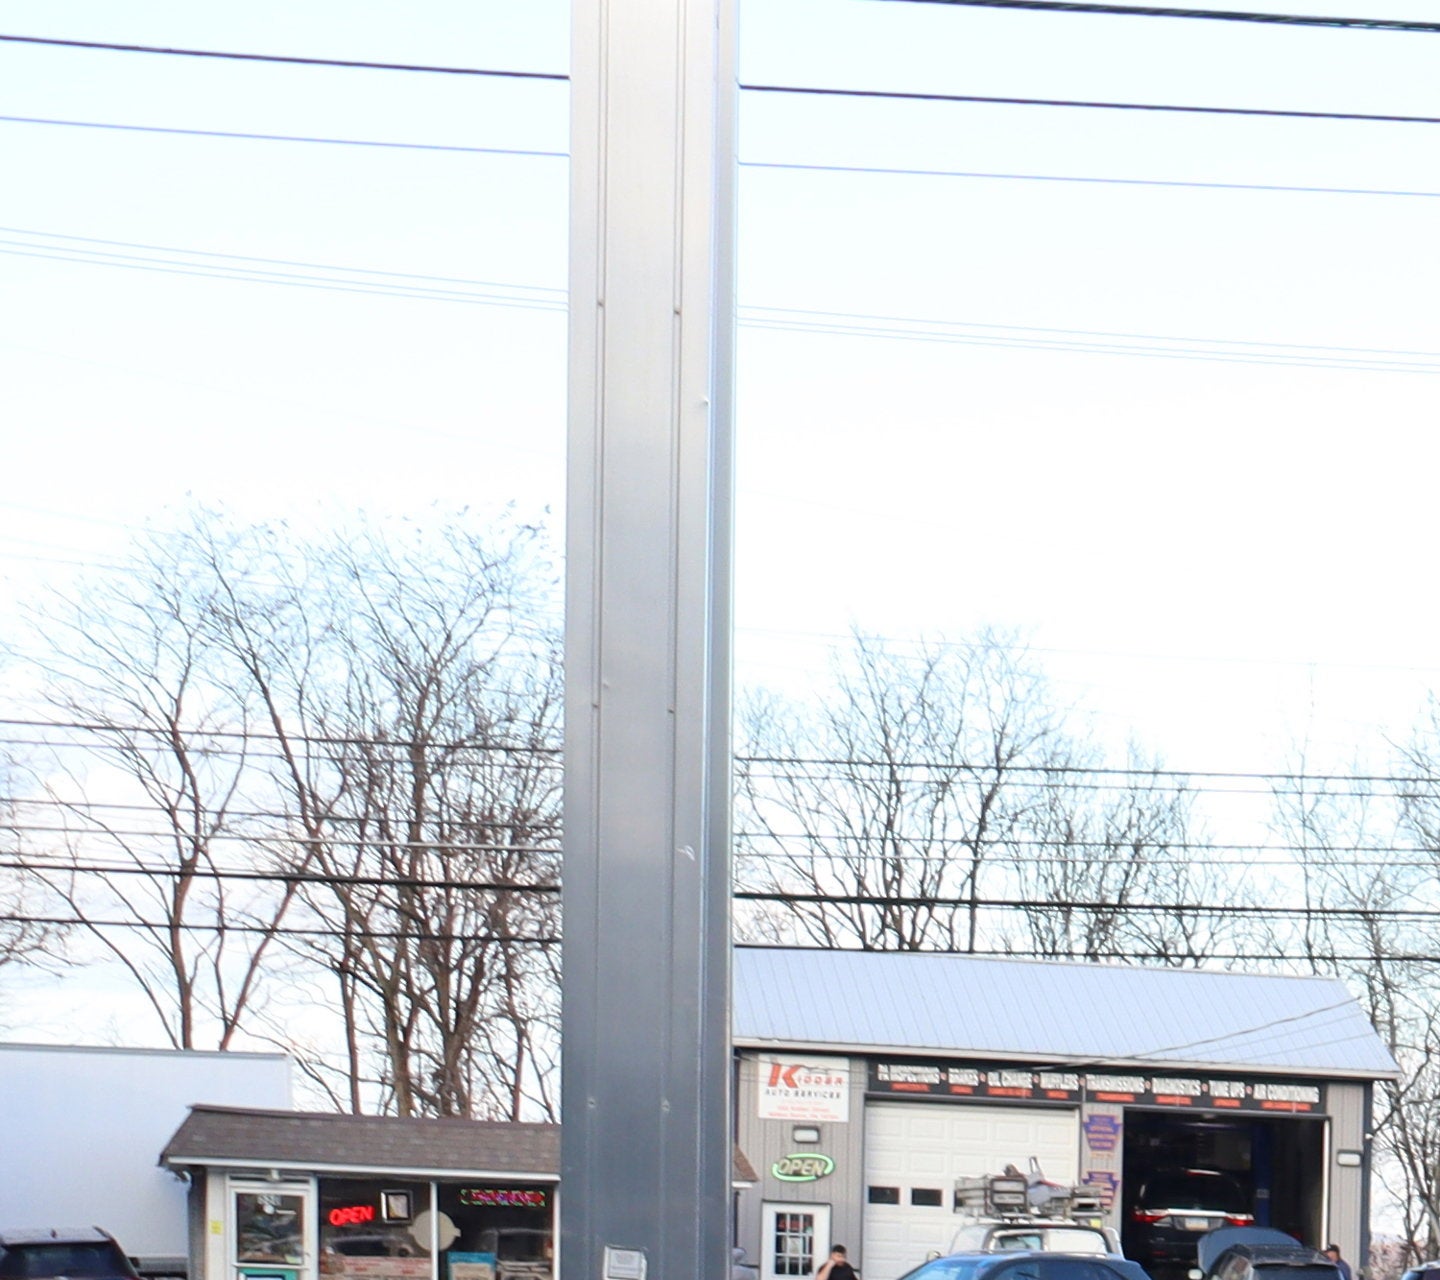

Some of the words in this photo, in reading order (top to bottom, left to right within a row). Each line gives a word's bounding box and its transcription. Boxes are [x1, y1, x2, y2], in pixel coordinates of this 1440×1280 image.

[765, 1089, 790, 1097] AUTO
[778, 1158, 825, 1176] OPEN
[329, 1205, 375, 1226] OPEN
